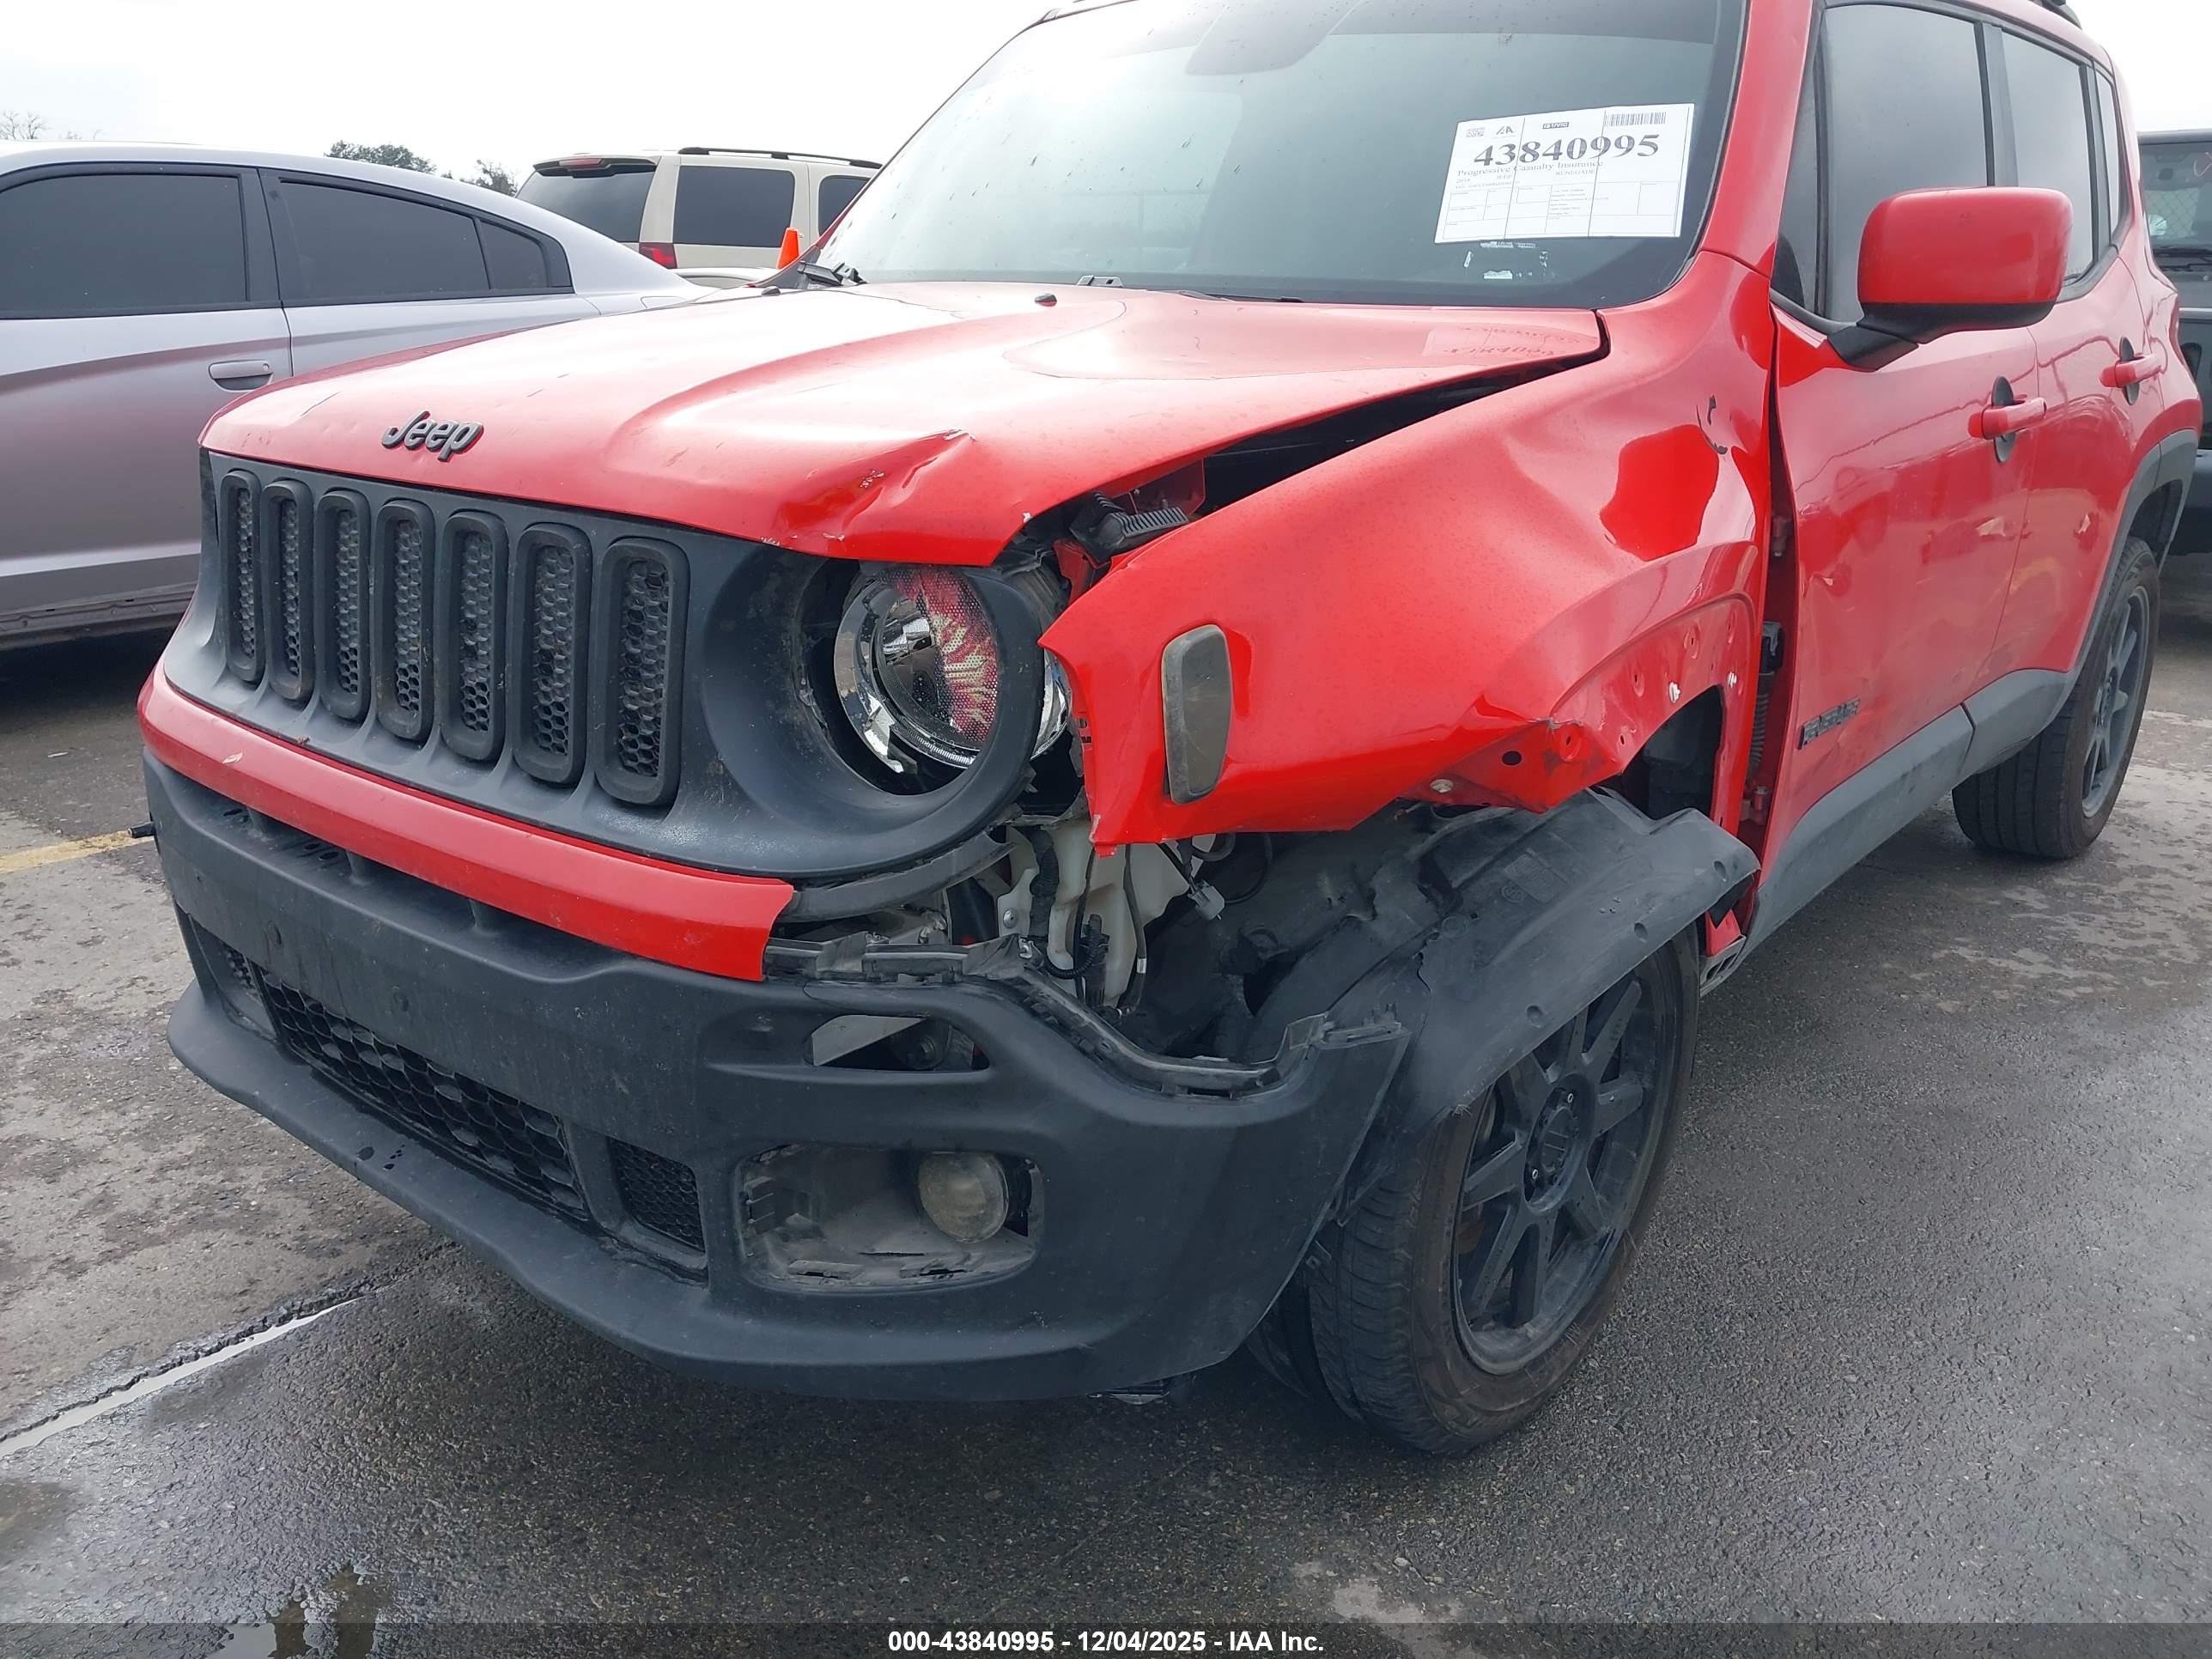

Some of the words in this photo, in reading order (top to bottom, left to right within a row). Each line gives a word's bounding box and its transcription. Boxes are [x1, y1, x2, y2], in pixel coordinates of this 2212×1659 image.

[1474, 134, 1660, 167] 43840995
[1457, 166, 1511, 178] Progressive
[382, 410, 484, 462] Jeep
